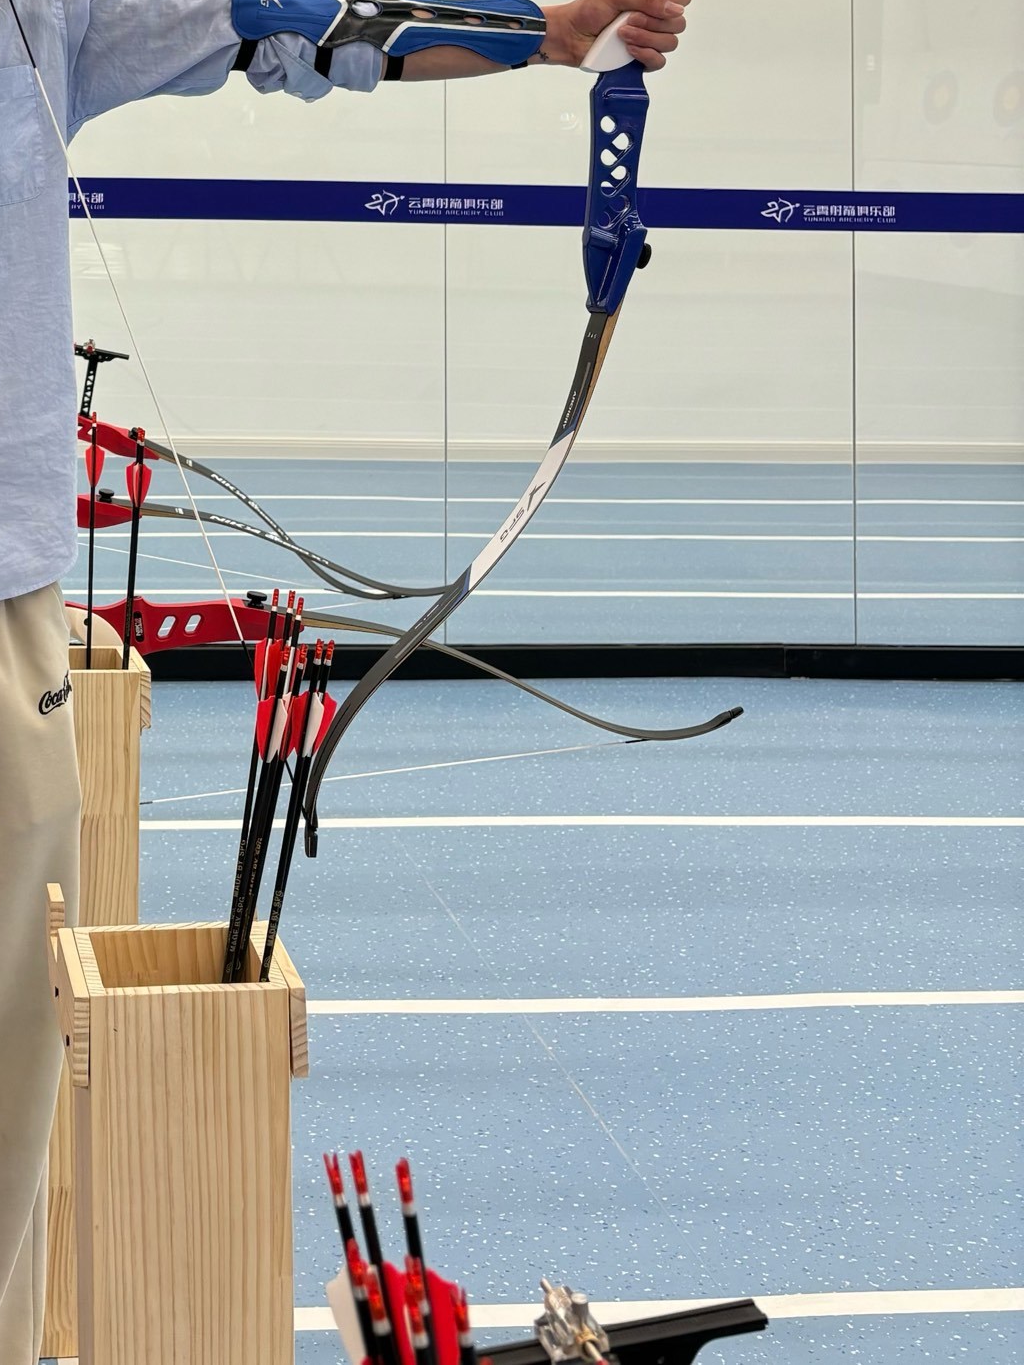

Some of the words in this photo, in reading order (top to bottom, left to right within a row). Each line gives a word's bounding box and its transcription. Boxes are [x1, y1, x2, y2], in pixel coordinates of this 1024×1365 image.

[409, 197, 503, 210] 云霄射箭俱乐部
[803, 204, 895, 217] 云霄射箭俱乐部
[229, 928, 238, 952] MADE
[237, 896, 245, 913] SPG
[267, 923, 276, 947] MADE
